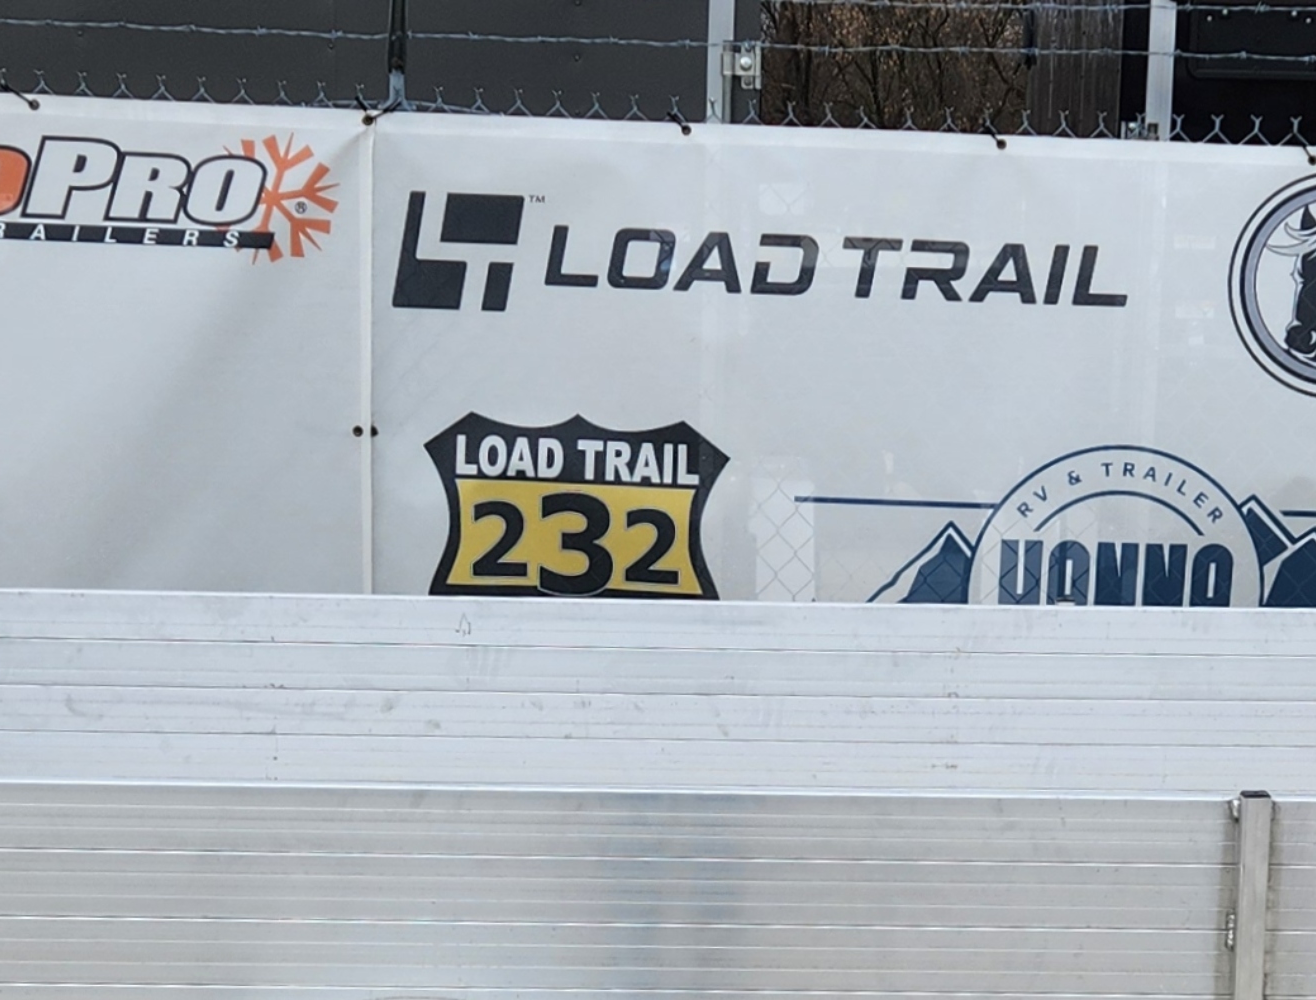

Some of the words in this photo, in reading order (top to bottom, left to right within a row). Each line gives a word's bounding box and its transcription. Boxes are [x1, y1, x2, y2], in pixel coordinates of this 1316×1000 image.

[544, 224, 820, 297] LOAD
[842, 237, 1129, 307] TRAIL
[454, 434, 565, 479] LOAD
[576, 439, 700, 487] TRAIL
[1016, 485, 1048, 518] RV
[1066, 470, 1082, 486] &
[1100, 461, 1224, 524] TRAILER
[470, 493, 680, 597] 232
